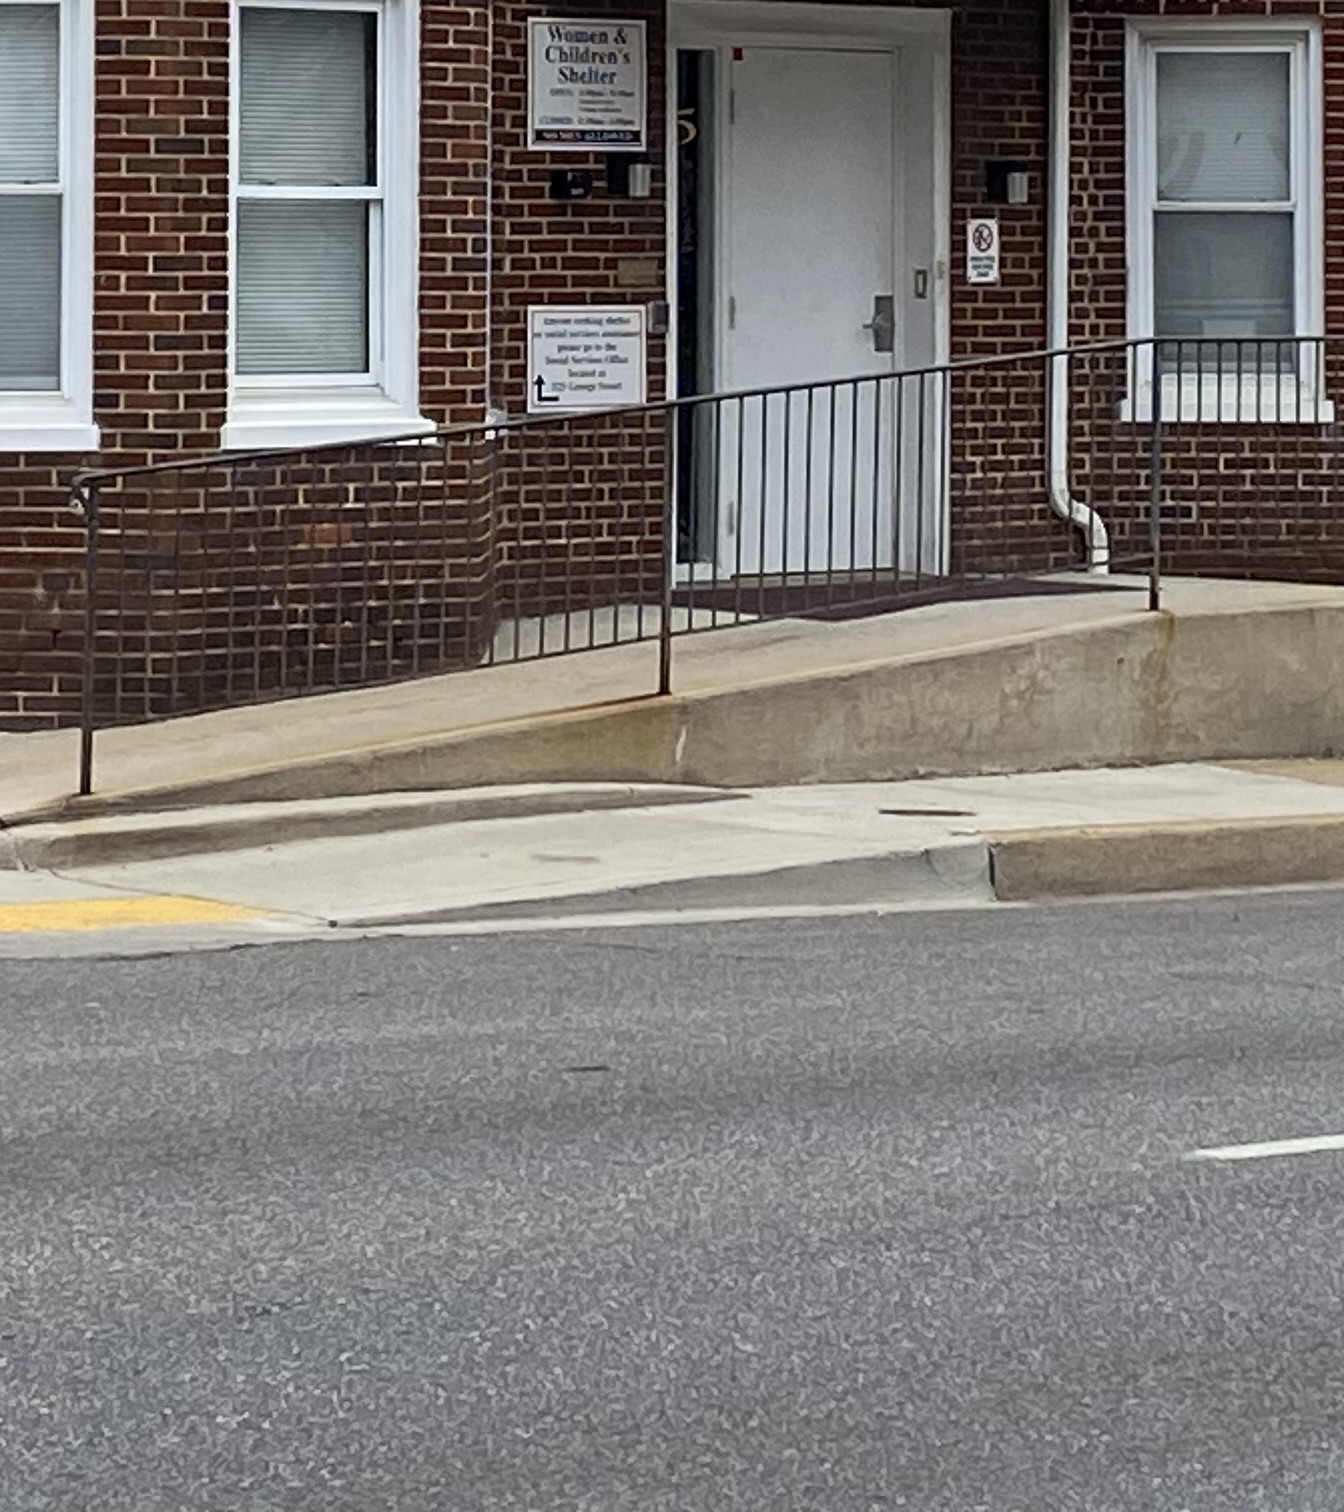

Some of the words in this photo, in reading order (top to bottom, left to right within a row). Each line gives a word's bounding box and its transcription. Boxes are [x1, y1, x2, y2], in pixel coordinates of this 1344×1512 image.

[547, 25, 608, 44] Women
[613, 28, 628, 44] &
[545, 45, 631, 65] Children's
[558, 66, 617, 85] Shelter
